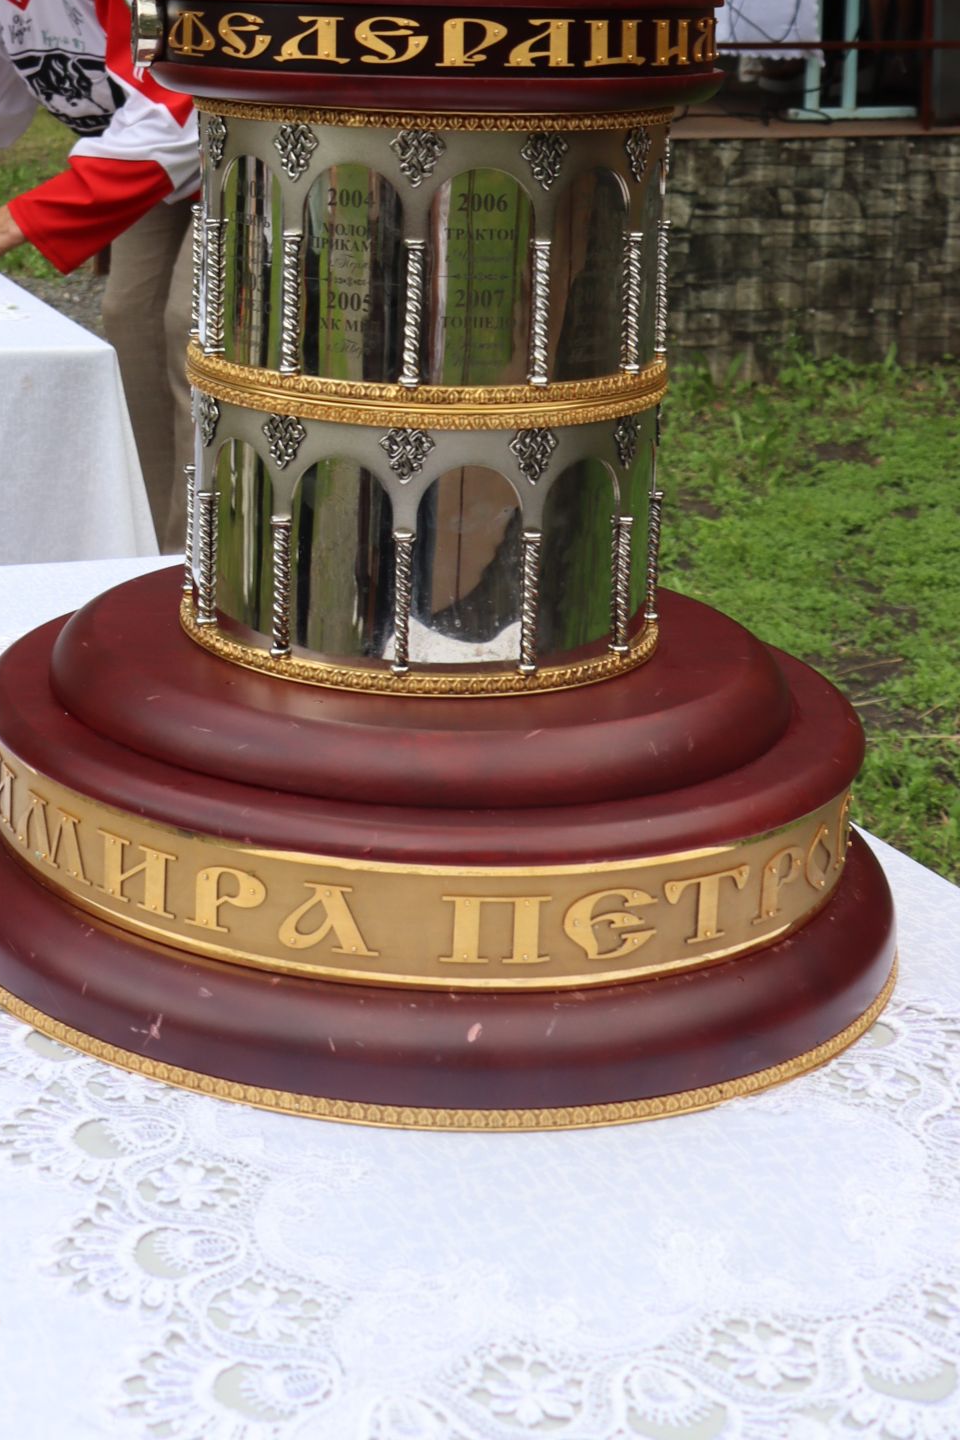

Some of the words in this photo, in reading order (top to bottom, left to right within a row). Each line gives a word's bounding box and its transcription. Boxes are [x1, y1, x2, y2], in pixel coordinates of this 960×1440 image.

[327, 187, 375, 208] 2004
[456, 192, 509, 212] 2006
[327, 291, 372, 312] 2005
[455, 288, 506, 308] 2007
